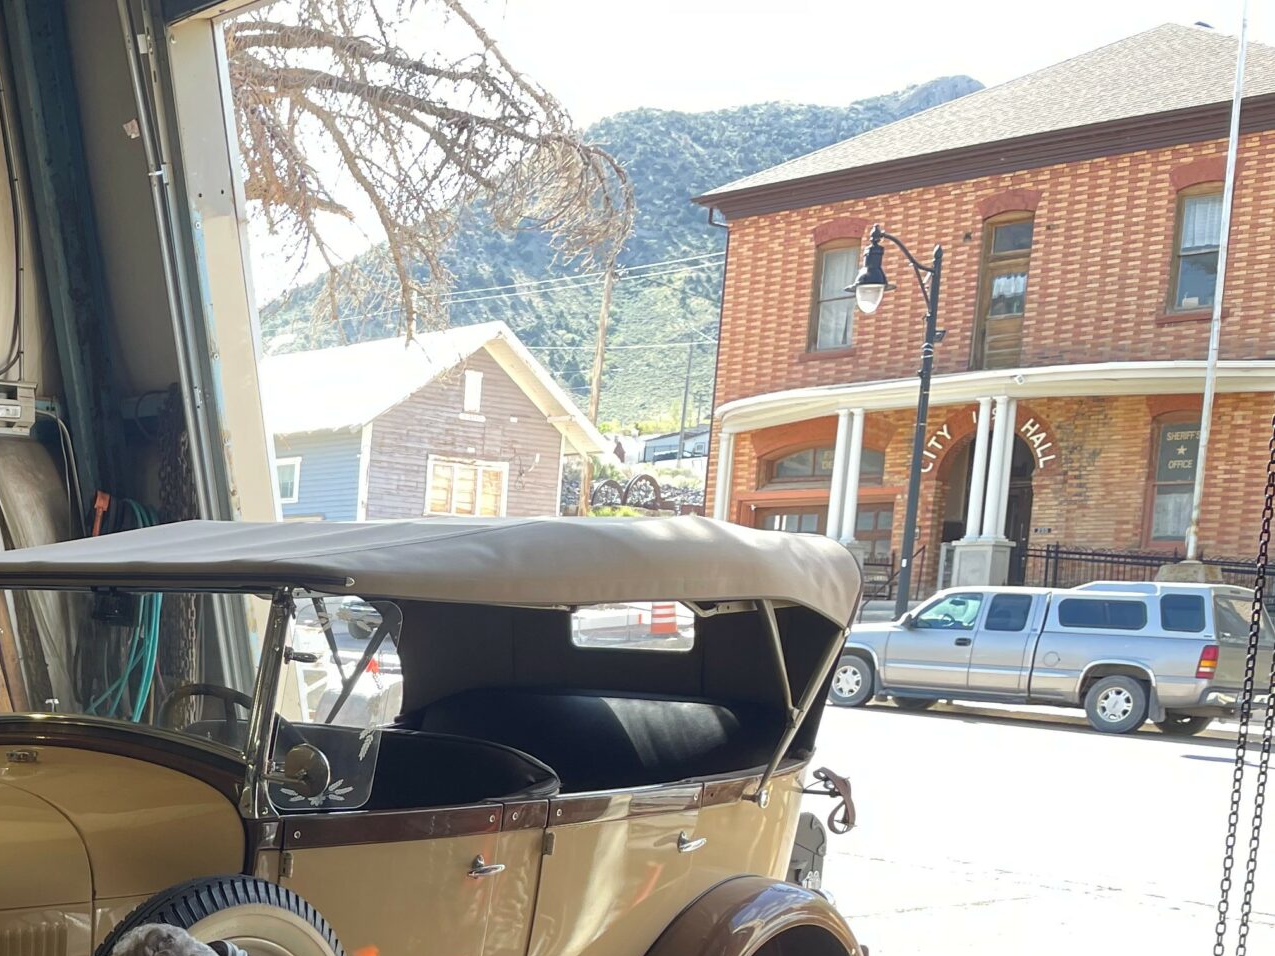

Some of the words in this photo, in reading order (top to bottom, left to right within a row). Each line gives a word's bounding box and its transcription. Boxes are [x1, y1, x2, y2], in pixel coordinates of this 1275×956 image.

[920, 424, 952, 473] CITY
[1021, 418, 1056, 469] HALL
[1168, 459, 1193, 469] OFFICE
